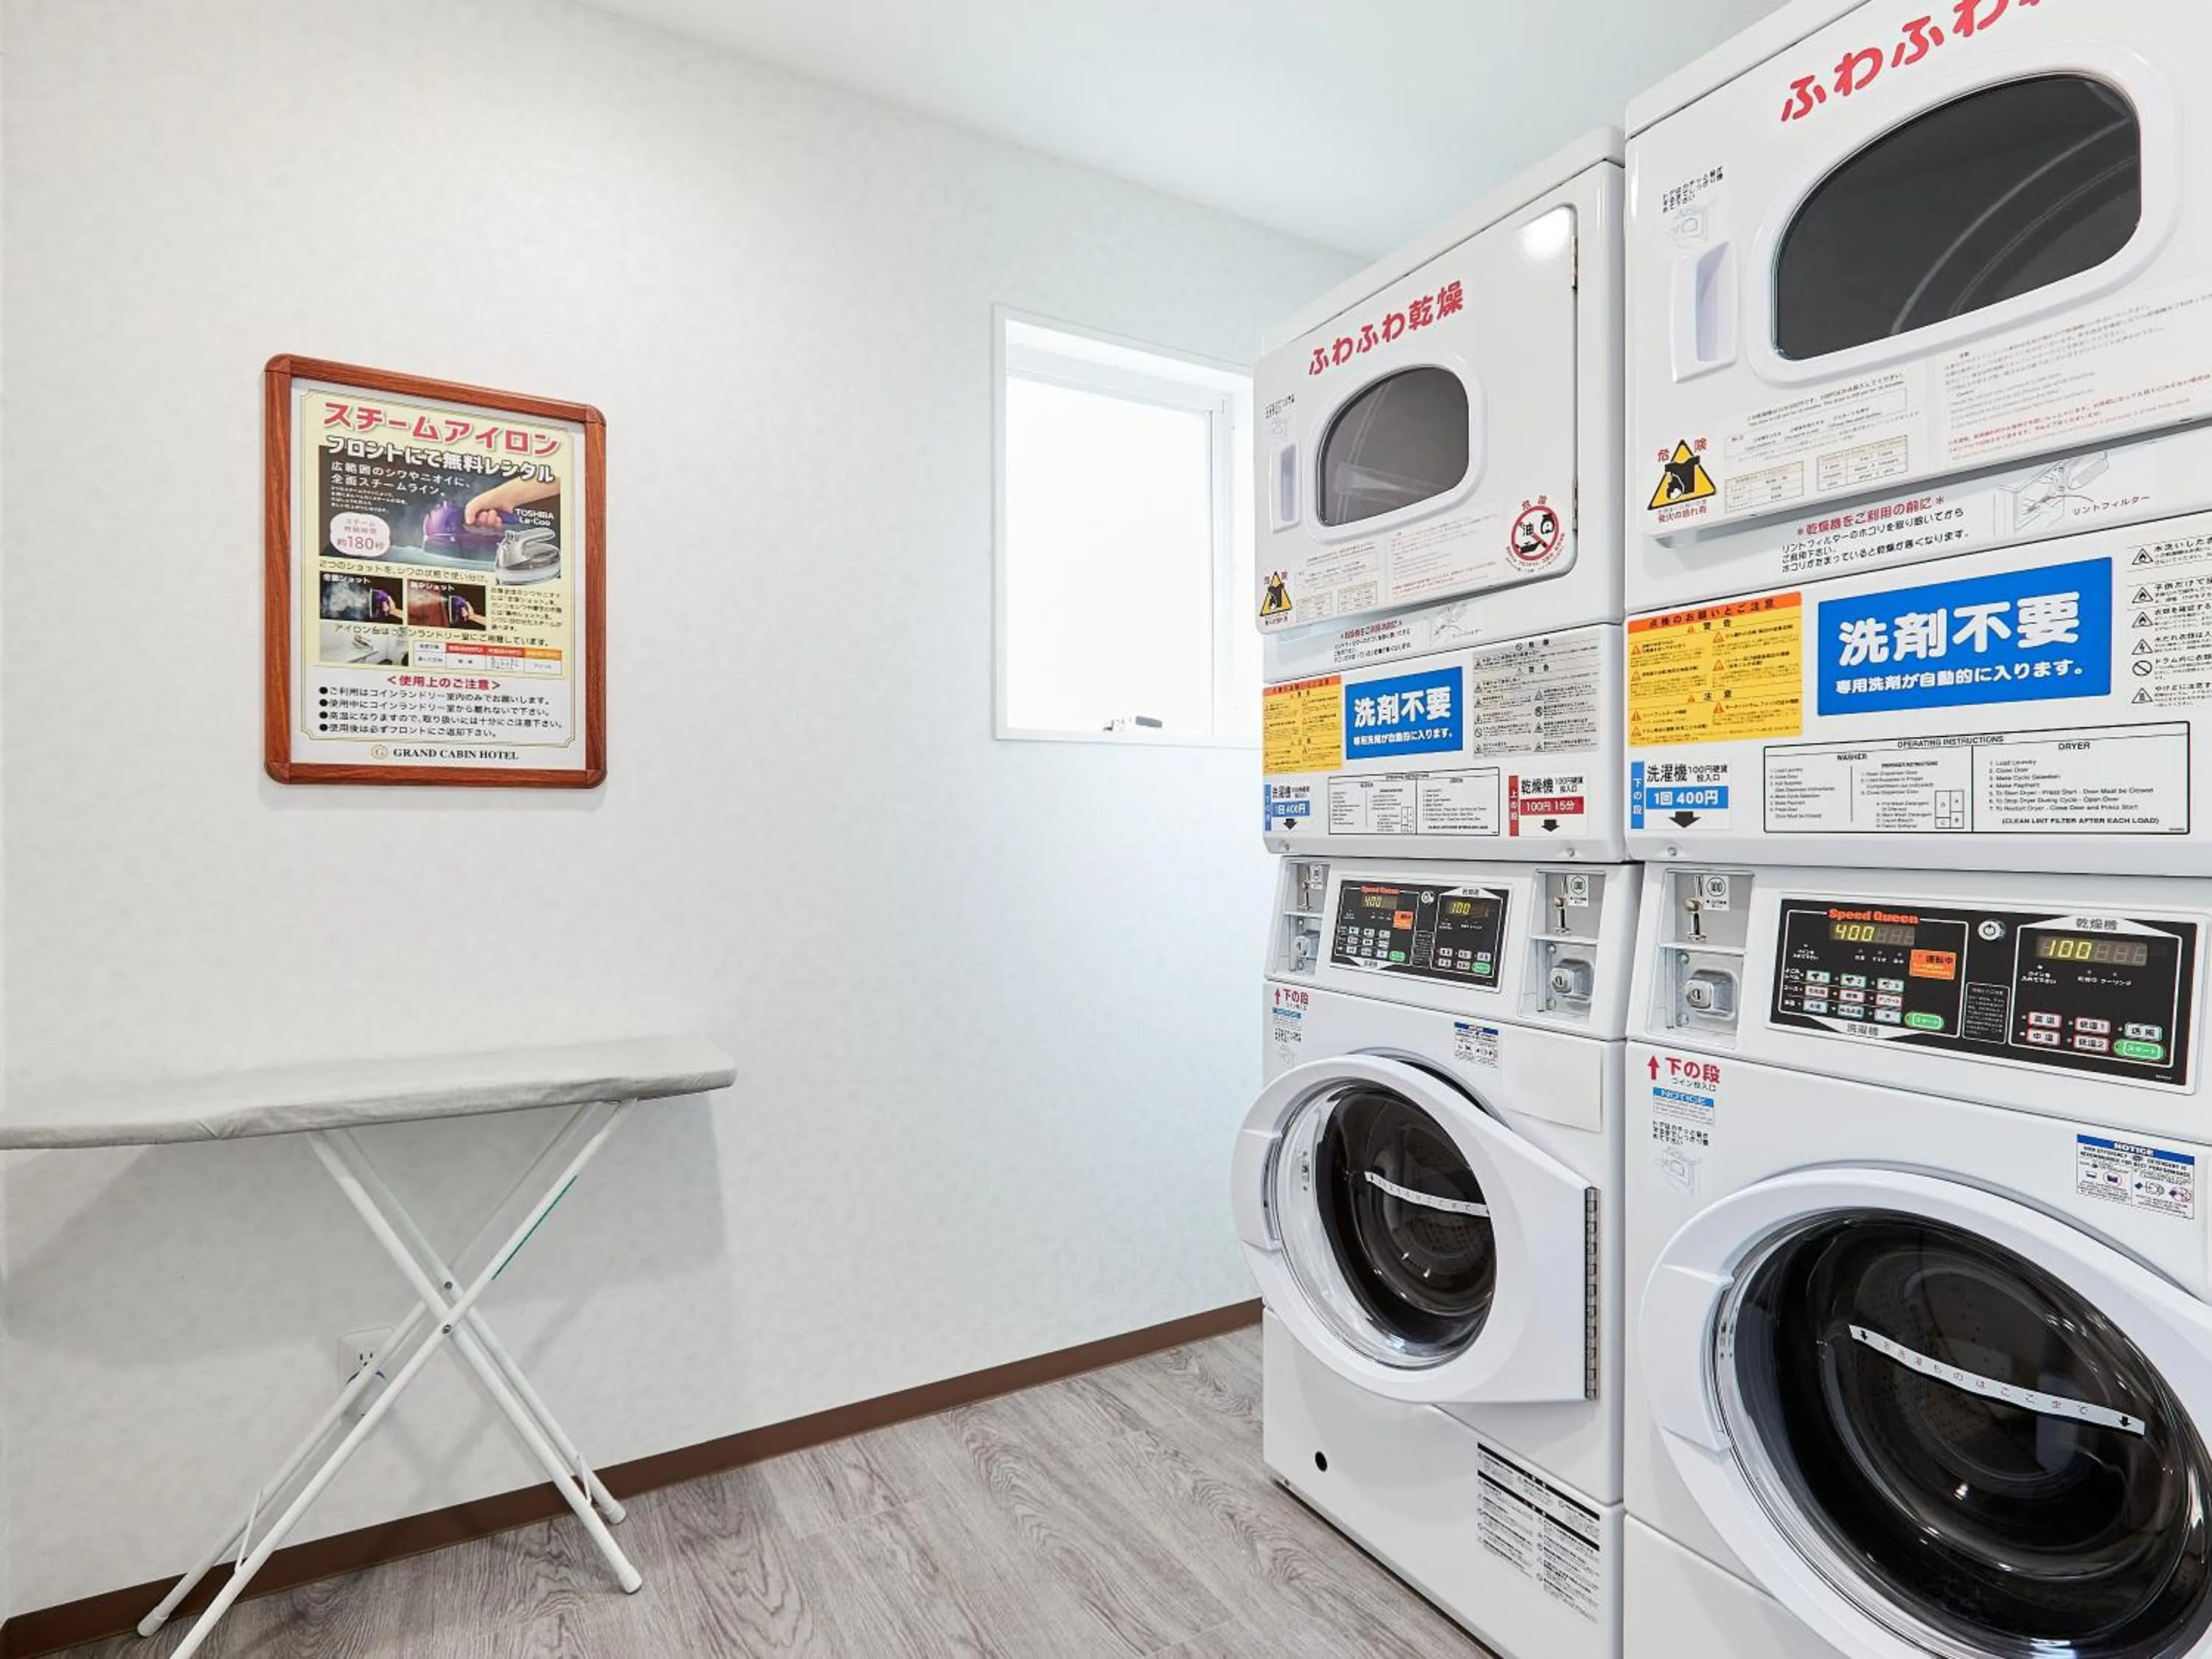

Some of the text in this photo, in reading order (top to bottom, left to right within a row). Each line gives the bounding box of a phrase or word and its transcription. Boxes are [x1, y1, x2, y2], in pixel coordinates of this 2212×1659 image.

[1781, 0, 2040, 121] ふわふわ
[1309, 280, 1464, 375] ふわふわ乾燥
[324, 402, 560, 456] スチームアイロン
[327, 435, 554, 482] フロントにて無料レンタル
[515, 508, 554, 519] TOSHIBA
[1523, 522, 1534, 536] 油
[1839, 591, 2080, 667] 洗剤不要
[1835, 658, 2083, 694] 専用洗剤が自動的に入ります。
[1354, 686, 1451, 728] 洗剤不要
[1896, 735, 2004, 748] OPERATING INSTRUCTIONS
[2058, 742, 2090, 750] DRYER
[393, 748, 437, 759] GRAND
[439, 749, 477, 759] CABIN
[479, 750, 520, 760] HOTEL
[1647, 764, 1687, 782] 洗濯機
[1697, 773, 1720, 782] 投入口
[1521, 777, 1554, 794] 乾燥機
[1526, 800, 1575, 812] 100円 15分
[1654, 790, 1719, 806] 1回 400円
[1364, 896, 1382, 908] 400
[1451, 901, 1471, 915] 100
[1828, 908, 1920, 925] Speed Queen
[2076, 918, 2118, 931] 乾燥機
[1835, 924, 1874, 942] 400
[2048, 939, 2093, 959] 100
[1283, 989, 1310, 1006] 下の段
[1846, 1022, 1879, 1037] 洗濯機
[1665, 1057, 1720, 1084] 下の段
[2114, 1142, 2154, 1156] NOTICE
